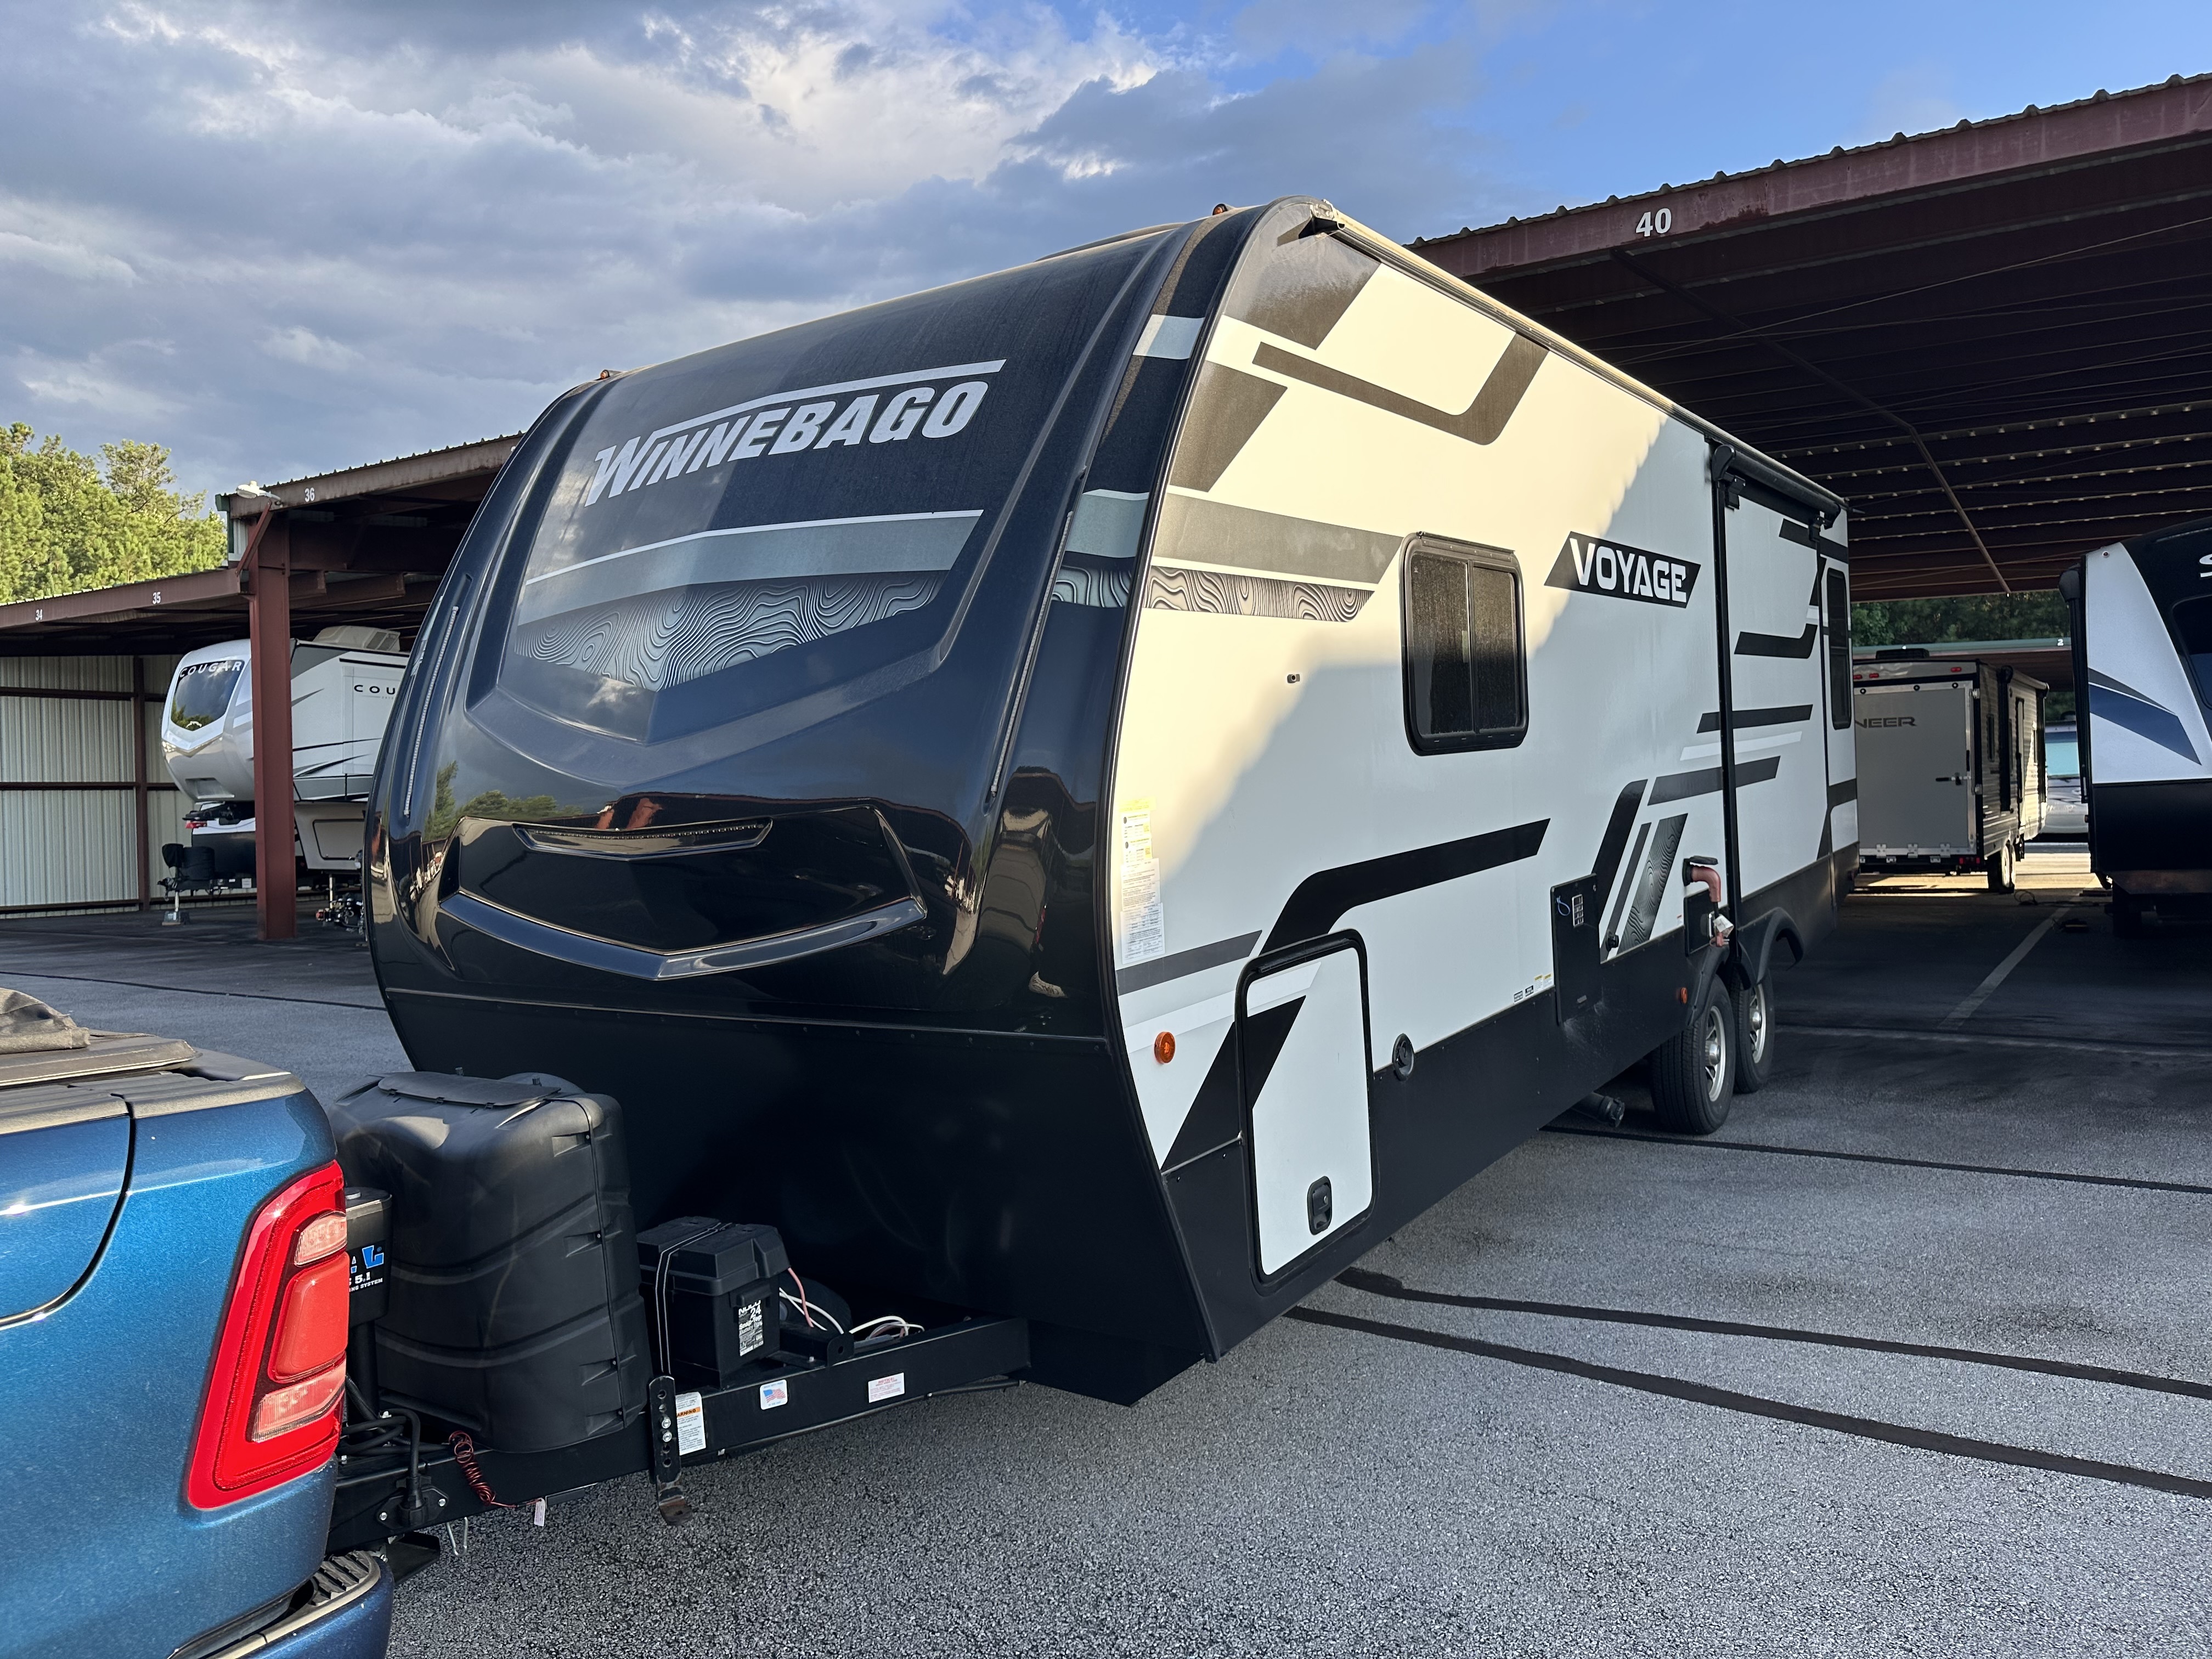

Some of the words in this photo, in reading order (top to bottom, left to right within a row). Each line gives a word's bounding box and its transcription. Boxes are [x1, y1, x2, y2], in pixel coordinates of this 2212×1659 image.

[1635, 207, 1672, 237] 40
[584, 379, 989, 507] WINNEBAGO
[304, 487, 315, 503] 36
[1569, 538, 1687, 603] VOYAGE
[152, 591, 161, 605] 35
[35, 609, 43, 621] 34
[2057, 638, 2064, 646] 2
[179, 661, 242, 678] COUGAR
[354, 684, 396, 695] COU
[360, 1277, 383, 1289] SYSTEM
[750, 1305, 761, 1319] 24
